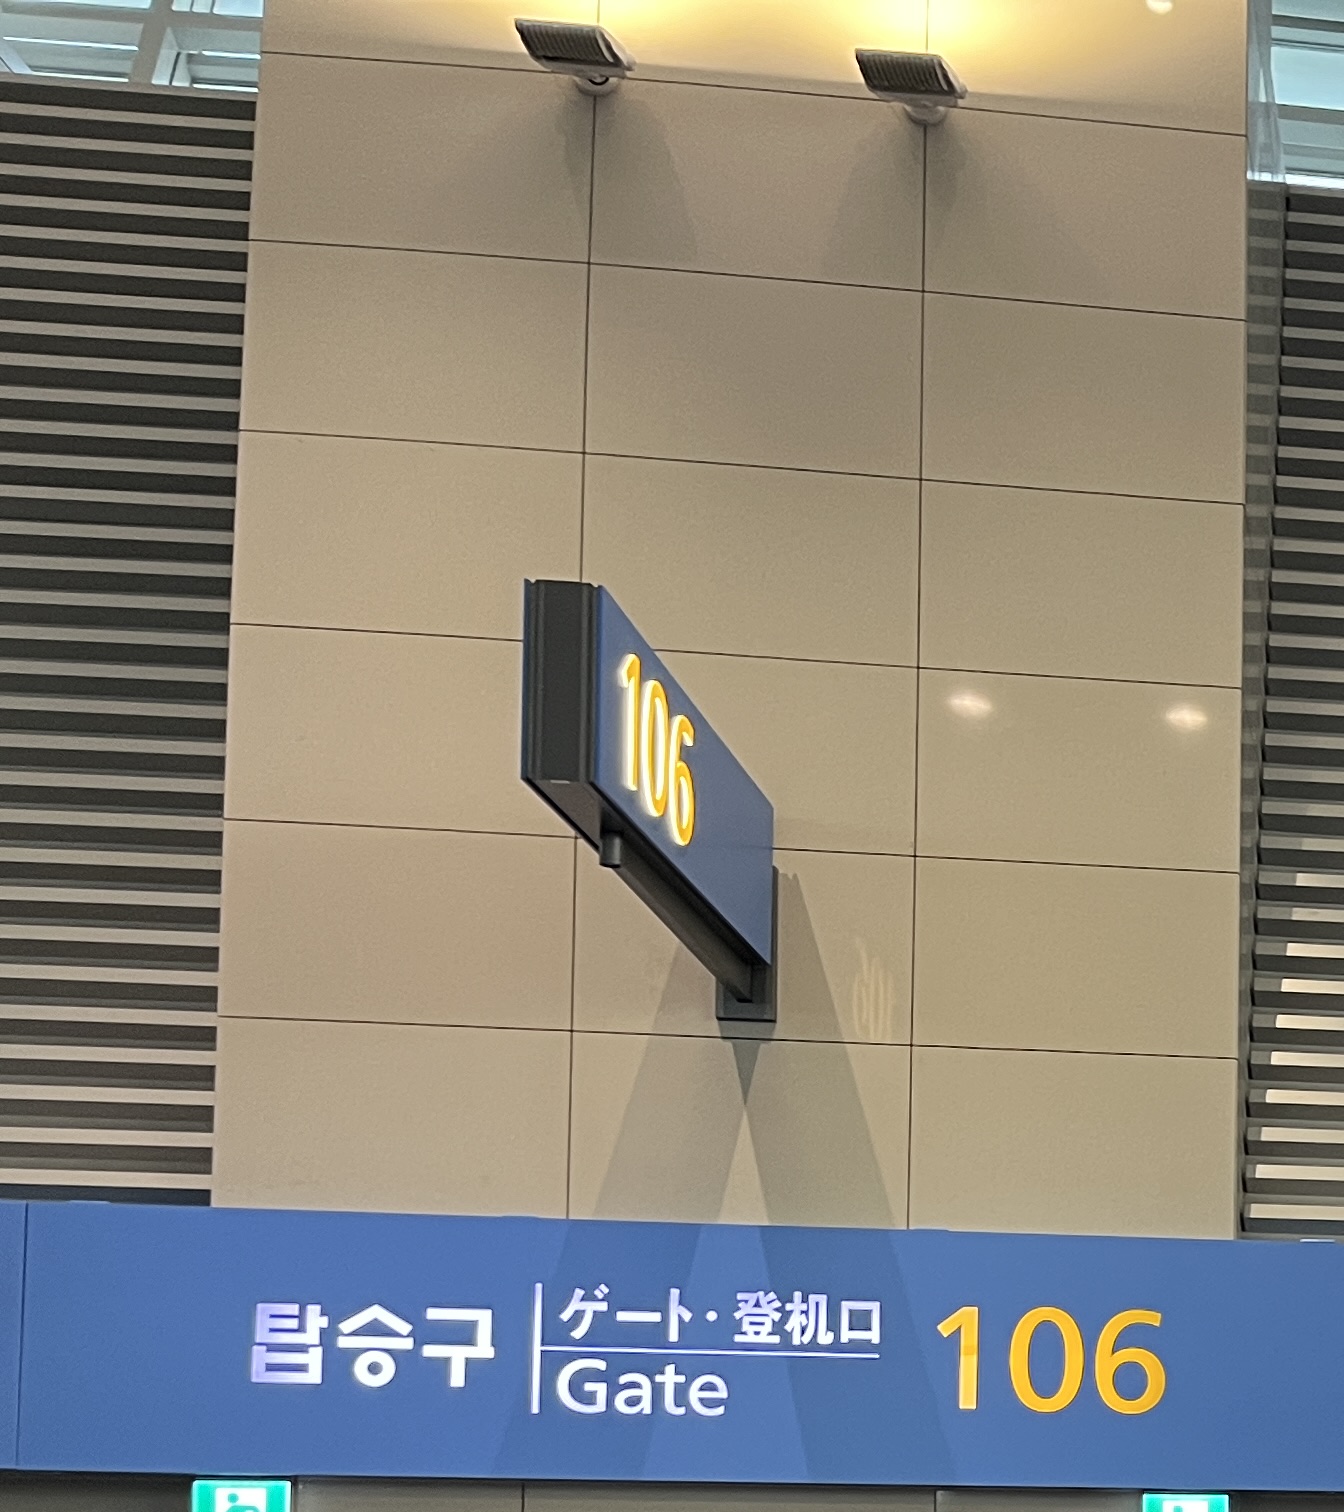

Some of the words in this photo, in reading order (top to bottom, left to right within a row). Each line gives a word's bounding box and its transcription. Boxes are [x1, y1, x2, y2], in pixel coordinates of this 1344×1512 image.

[618, 653, 695, 846] 106
[251, 1302, 496, 1388] 탑승구
[556, 1357, 729, 1419] Gate
[937, 1305, 1168, 1415] 106
